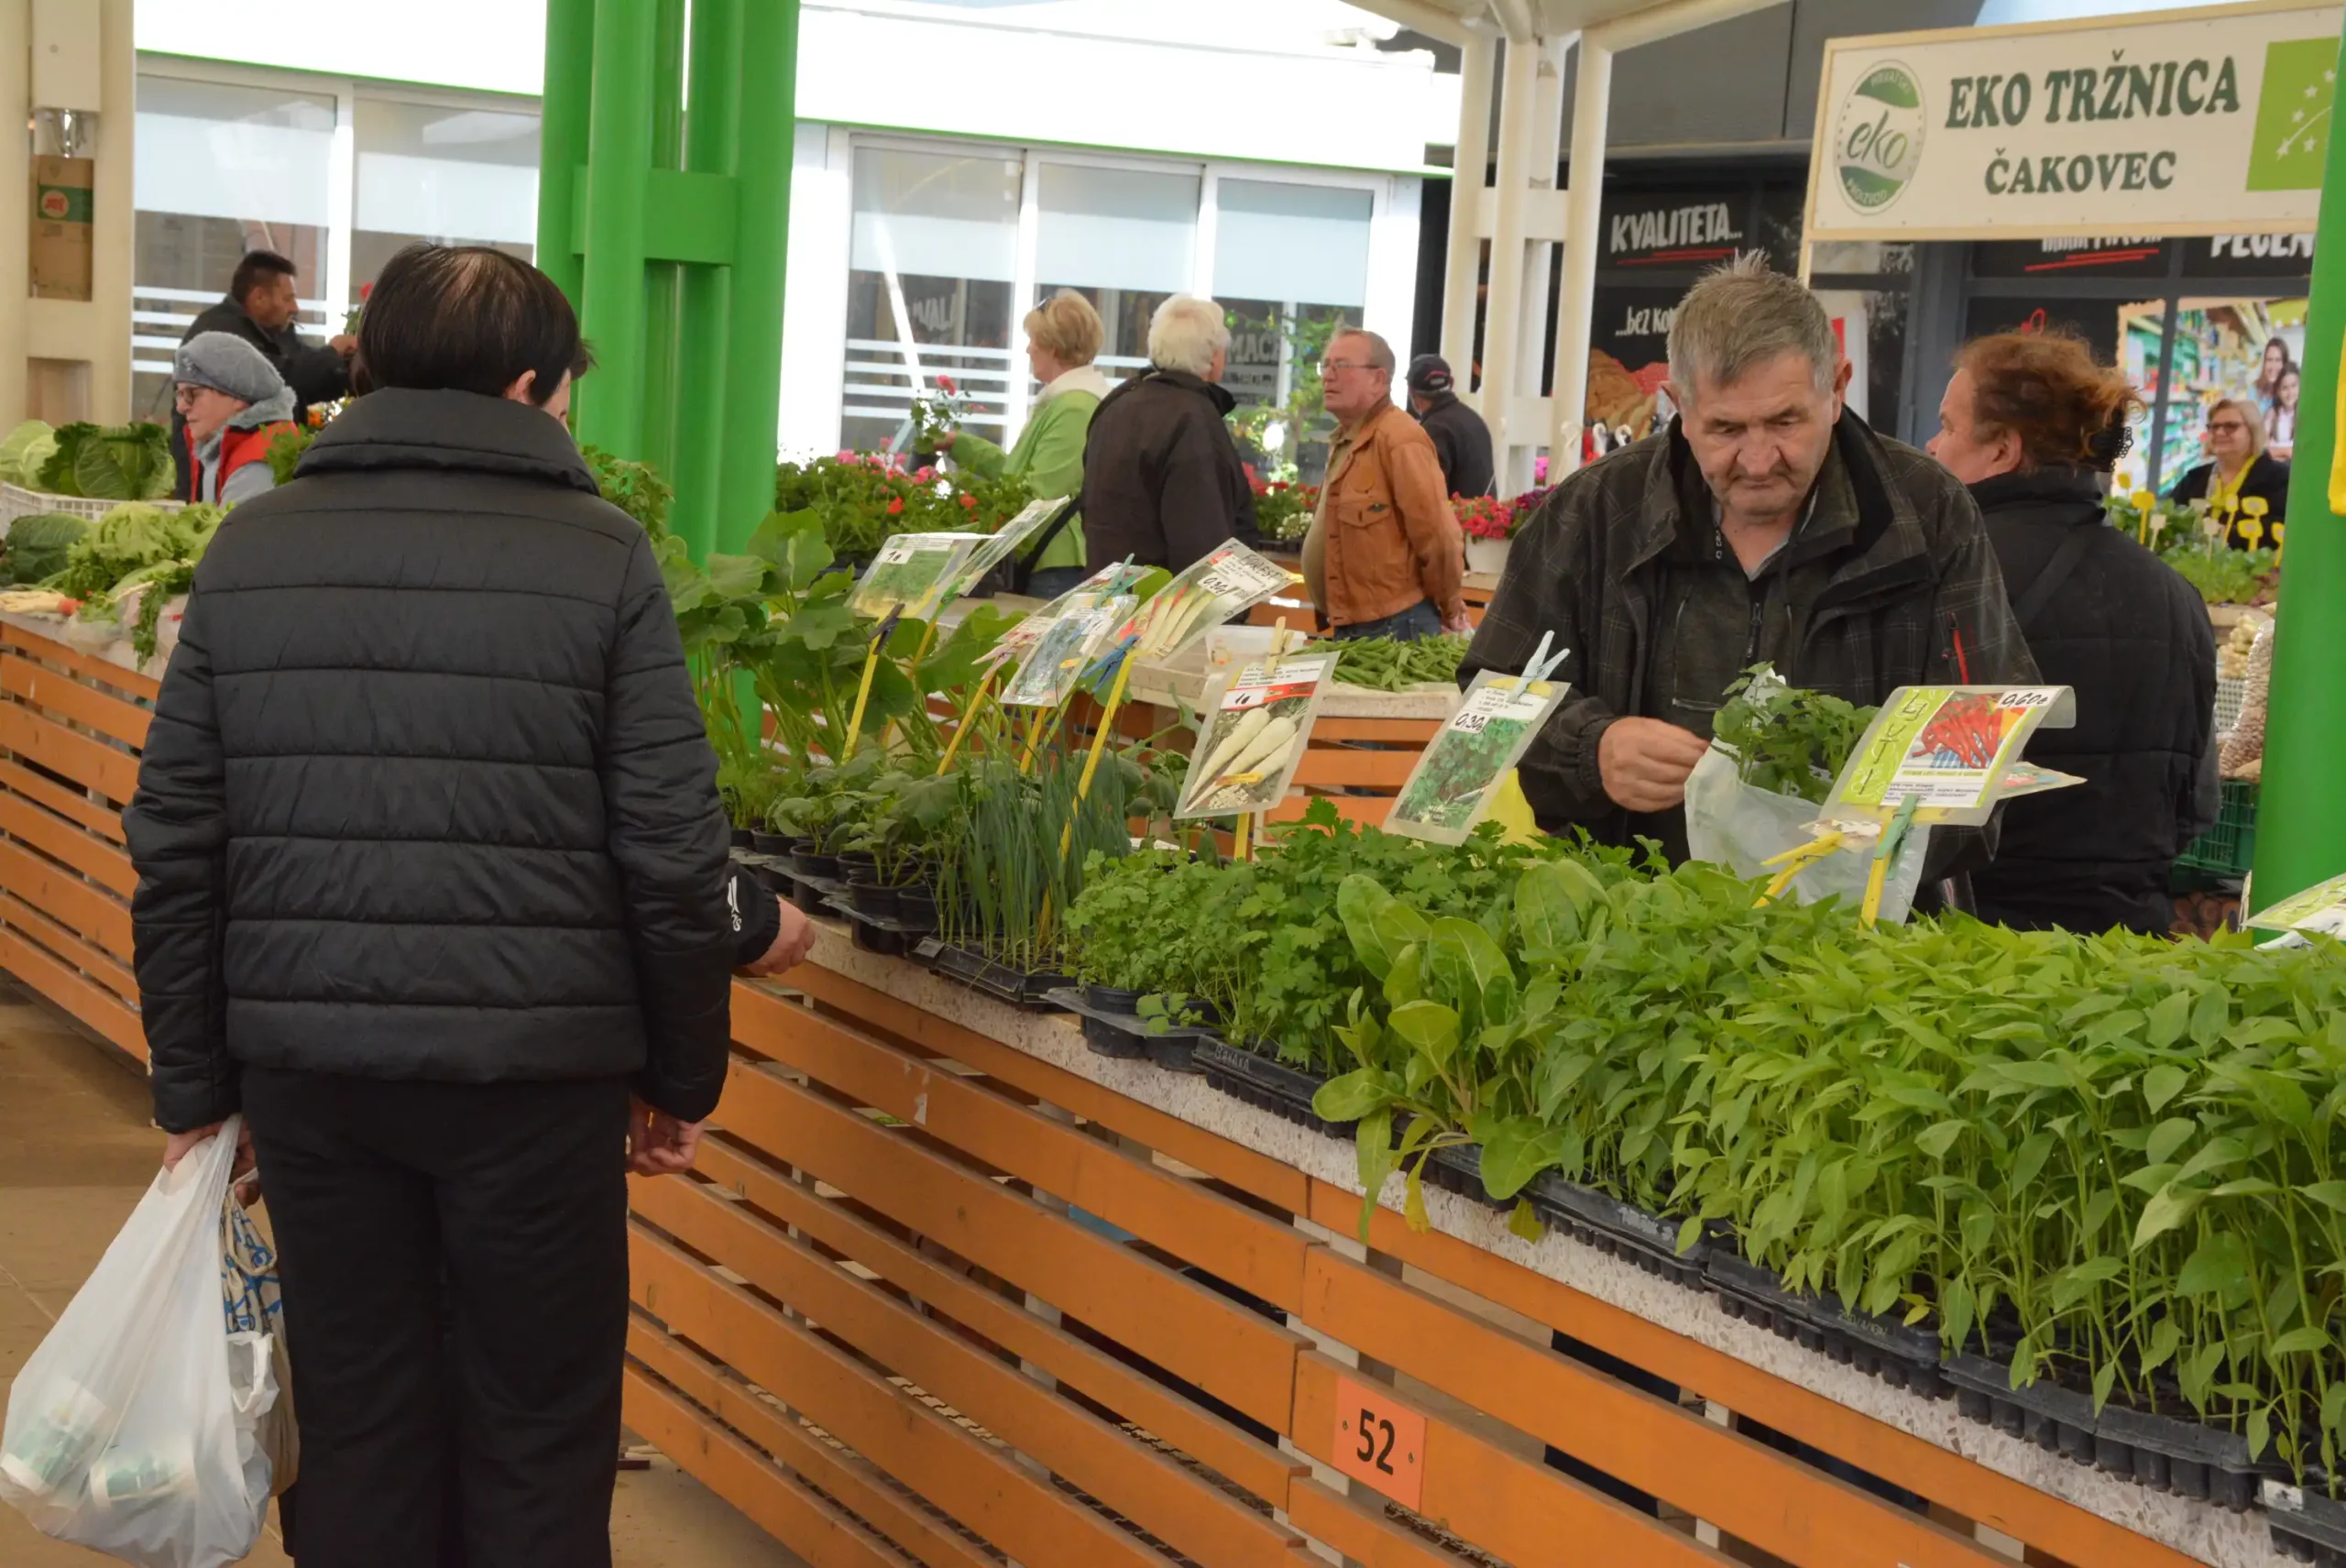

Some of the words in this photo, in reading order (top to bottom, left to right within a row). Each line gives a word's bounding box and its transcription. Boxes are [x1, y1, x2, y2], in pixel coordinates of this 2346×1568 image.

[1945, 72, 2032, 128] EKO
[2045, 49, 2241, 123] TRŽNICA
[1847, 109, 1907, 169] eko
[1984, 148, 2176, 195] ČAKOVEC
[1356, 1408, 1396, 1476] 52
